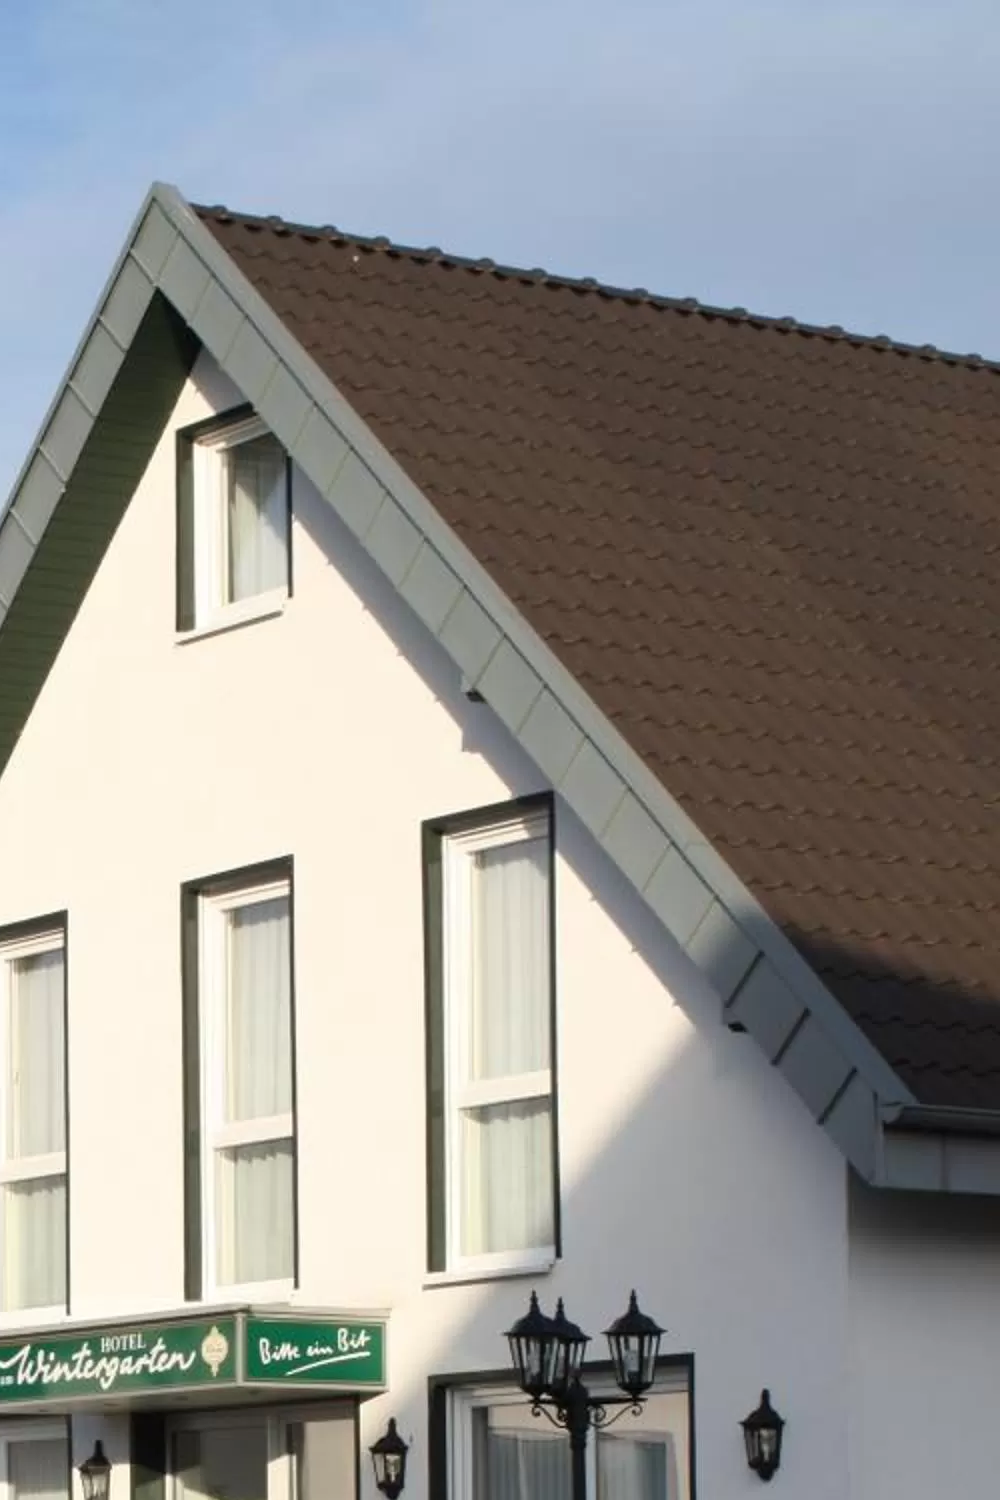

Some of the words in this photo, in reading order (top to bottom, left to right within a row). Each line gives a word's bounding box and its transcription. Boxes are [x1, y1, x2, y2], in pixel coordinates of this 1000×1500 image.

[101, 1333, 147, 1353] HOTEL
[259, 1337, 300, 1365] Bitte
[306, 1341, 334, 1356] ein
[338, 1327, 371, 1352] Bit
